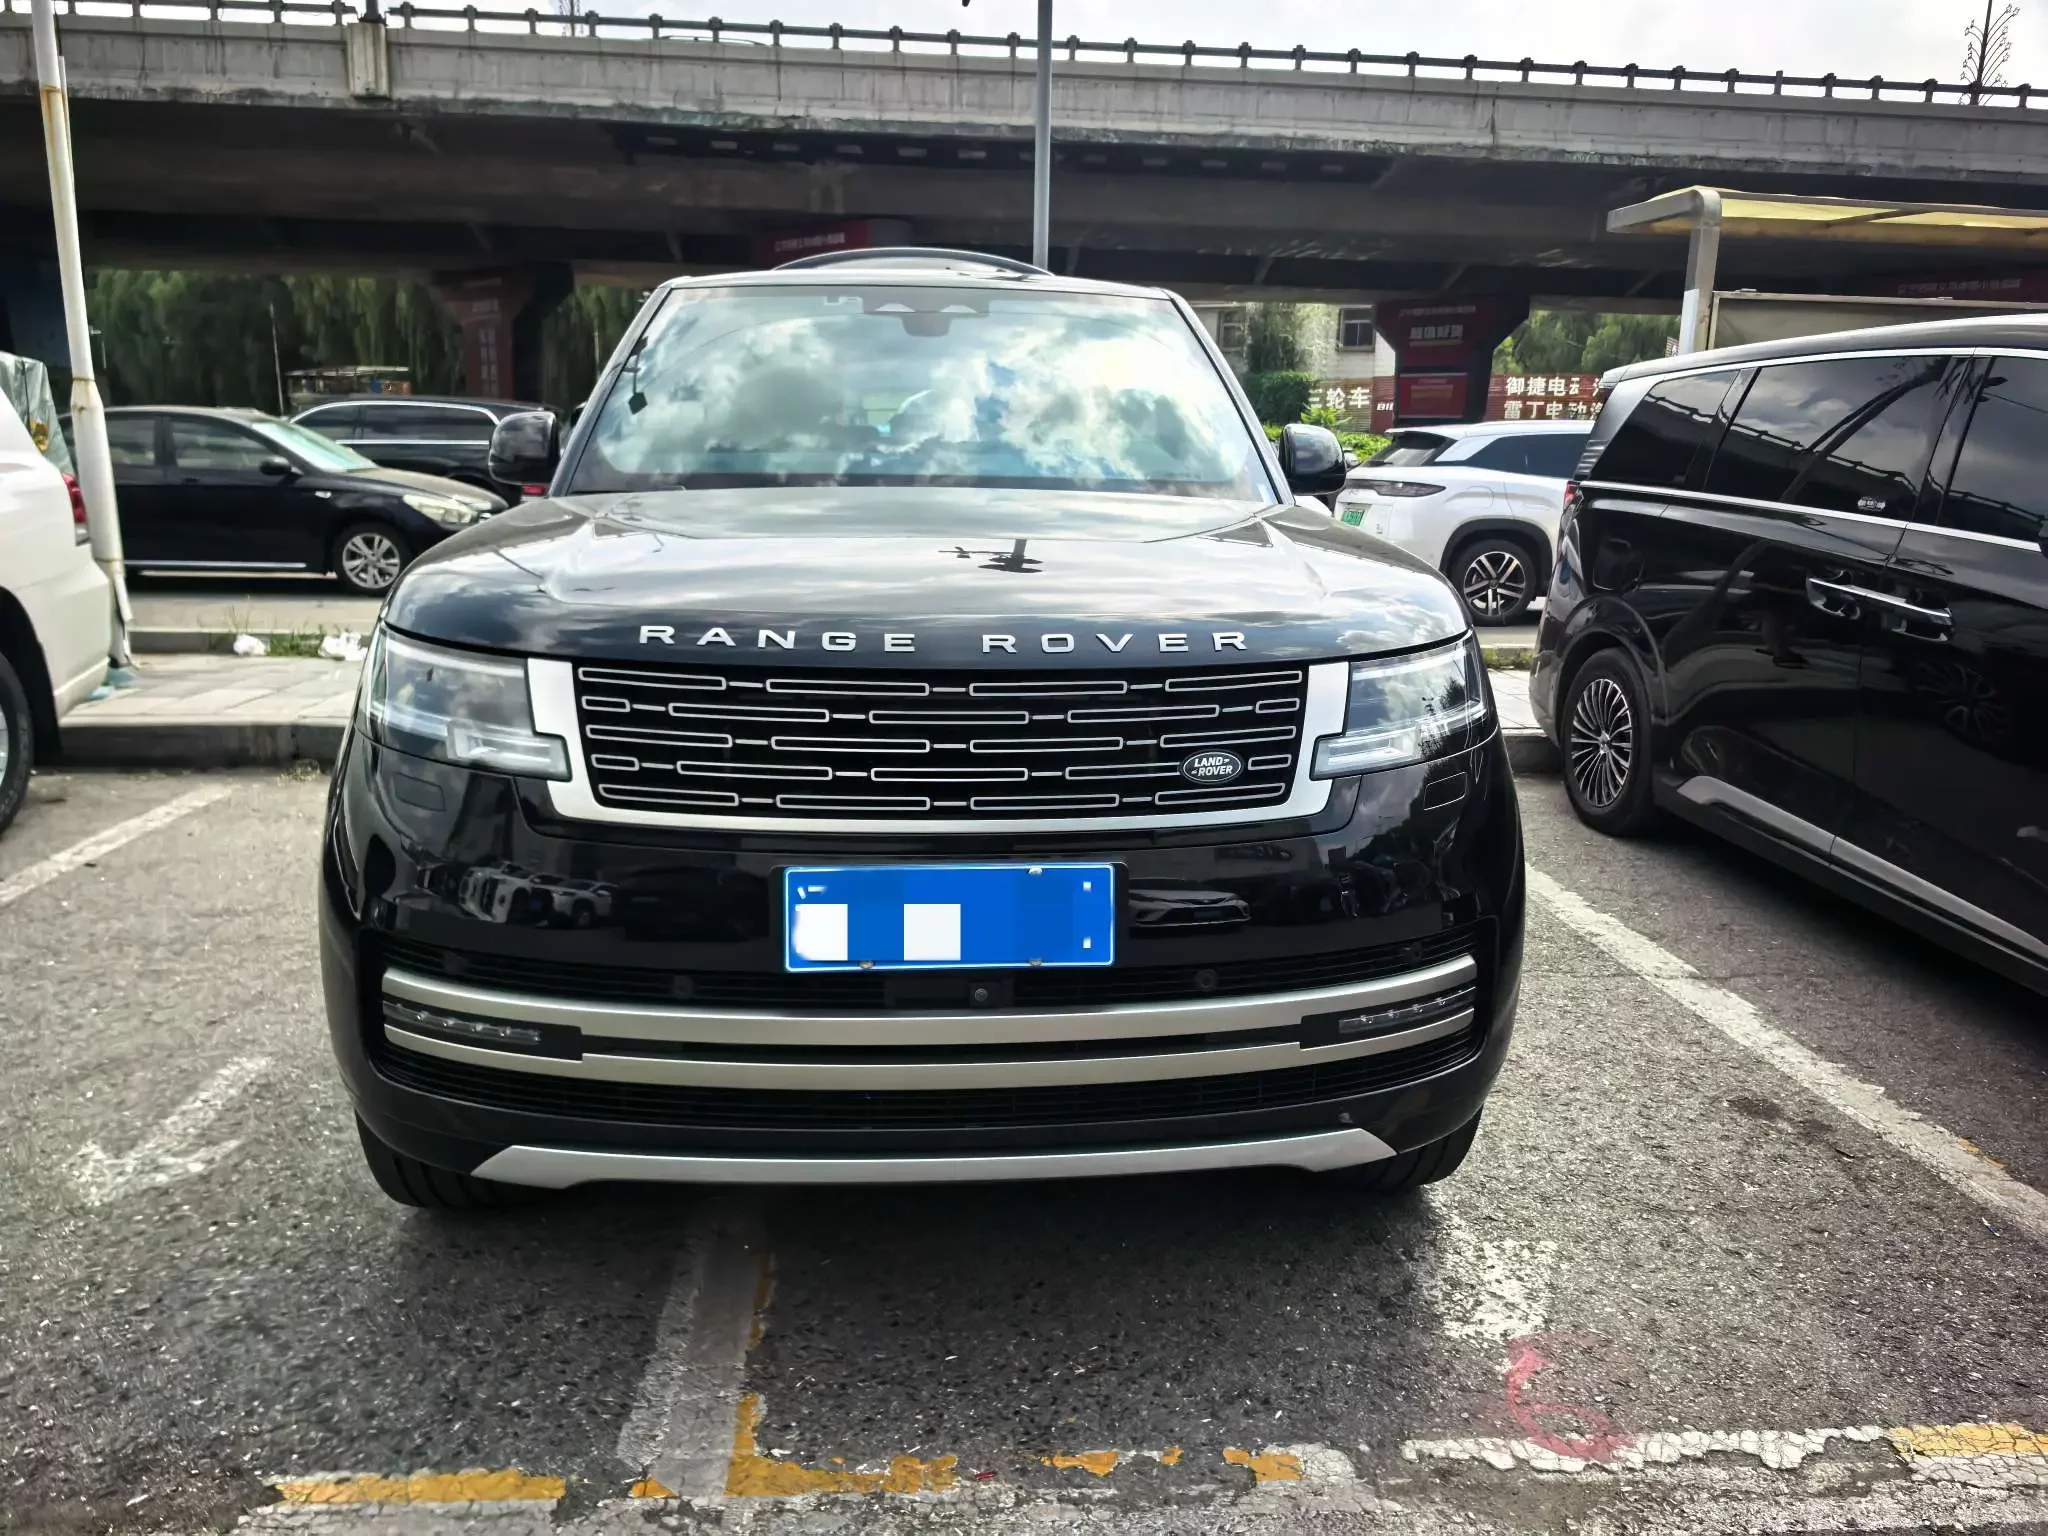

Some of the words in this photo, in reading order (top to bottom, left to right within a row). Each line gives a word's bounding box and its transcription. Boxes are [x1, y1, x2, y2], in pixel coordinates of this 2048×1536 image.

[1308, 386, 1369, 408] 三轮车
[639, 624, 916, 652] RANGE
[982, 631, 1248, 653] ROVER
[1194, 756, 1223, 767] LAND
[1198, 765, 1233, 776] ROVER
